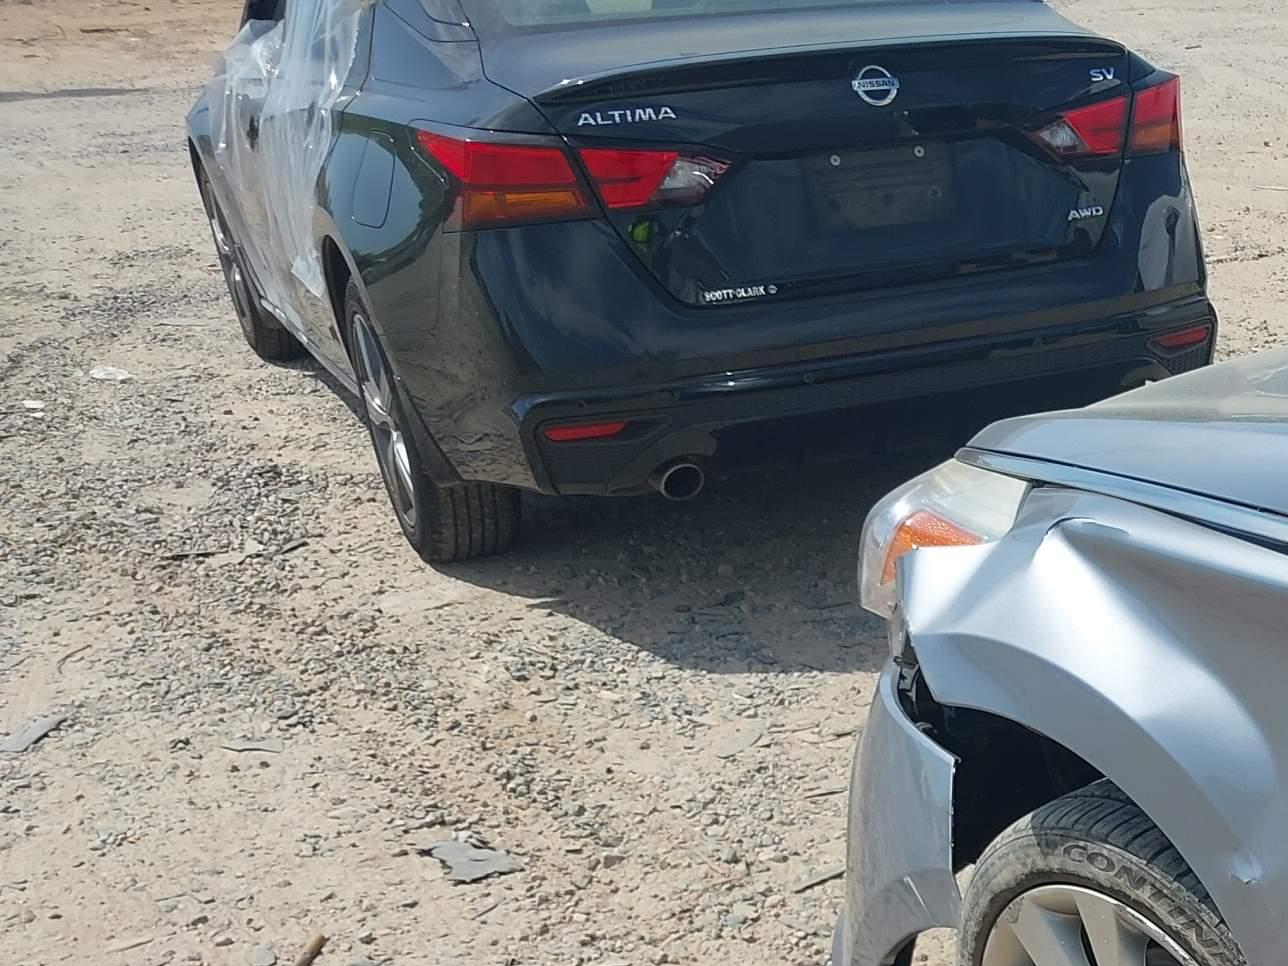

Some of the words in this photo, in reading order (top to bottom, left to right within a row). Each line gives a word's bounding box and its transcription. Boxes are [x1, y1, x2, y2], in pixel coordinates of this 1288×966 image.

[1089, 67, 1115, 81] SV
[857, 79, 896, 89] NISSAN
[577, 106, 677, 126] ALTIMA
[1067, 206, 1104, 221] AWD
[704, 289, 735, 302] SCOTT
[736, 285, 766, 298] CLARK
